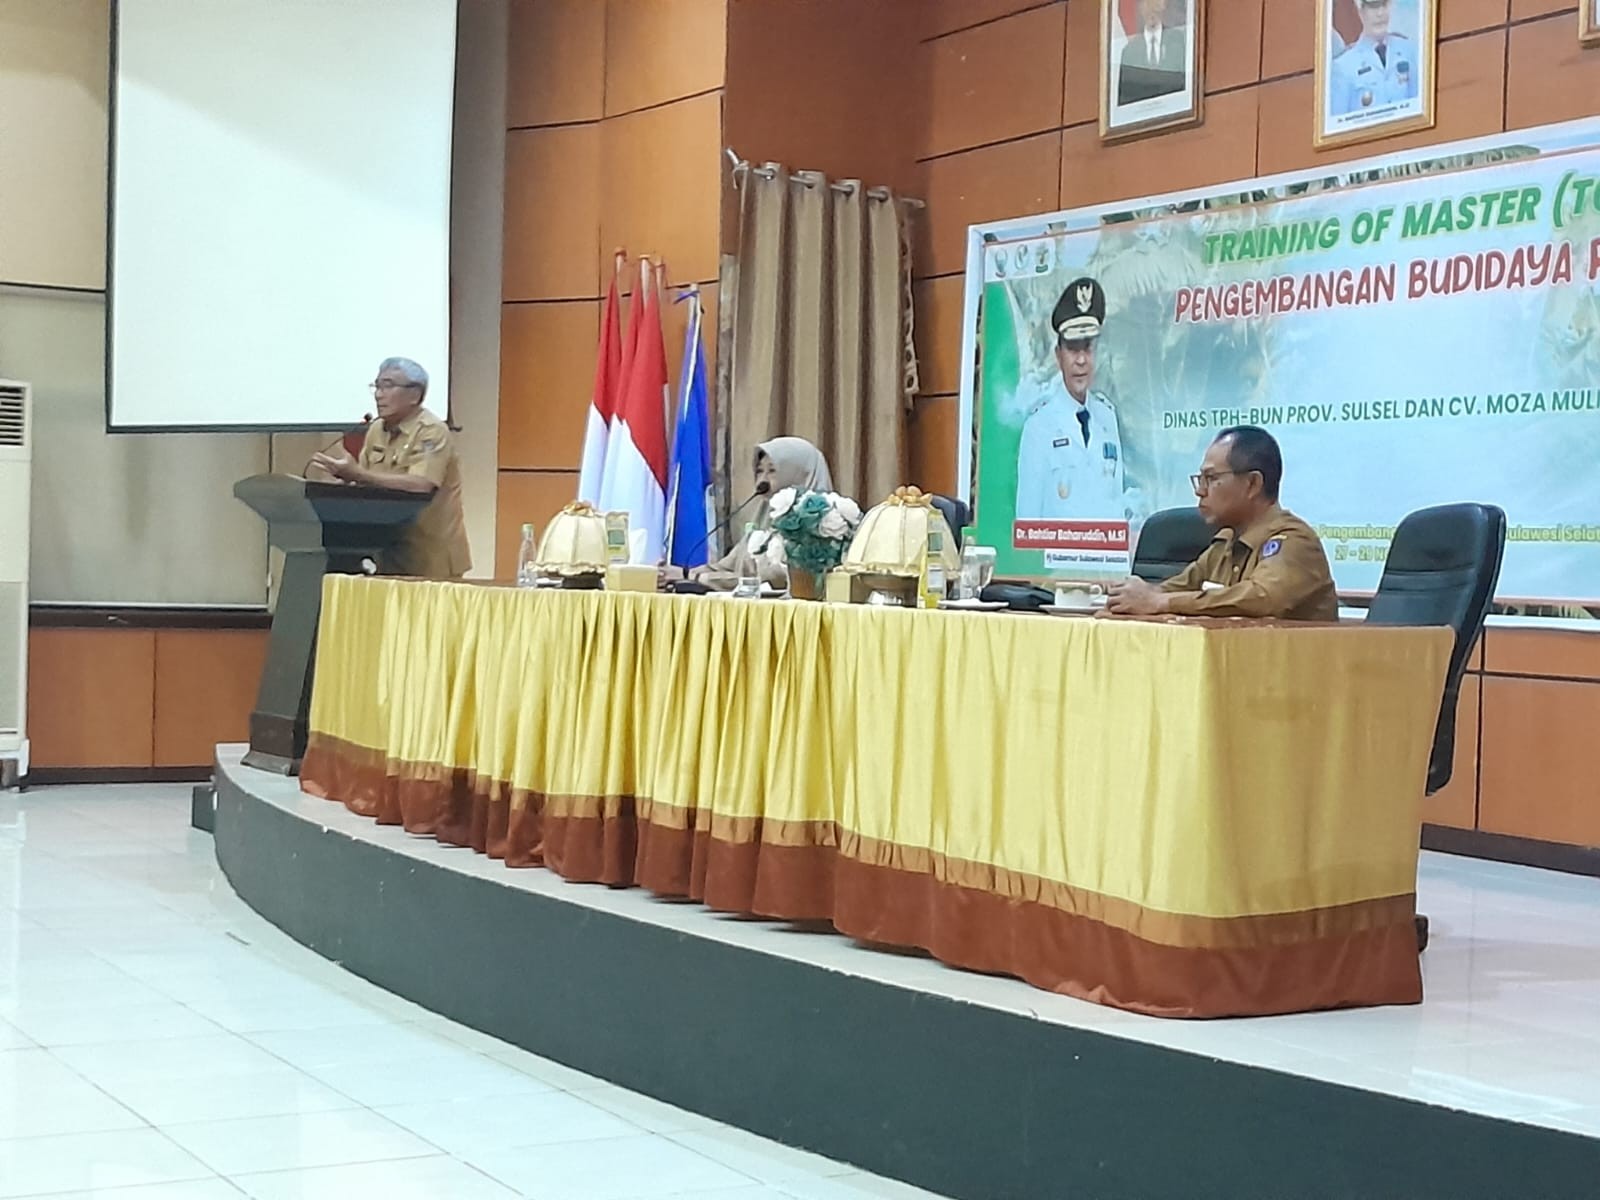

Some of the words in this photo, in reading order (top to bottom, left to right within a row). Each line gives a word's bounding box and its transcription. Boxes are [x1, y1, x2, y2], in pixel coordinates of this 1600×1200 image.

[1204, 216, 1341, 265] TRAINING
[1351, 207, 1394, 245] OF
[1401, 186, 1542, 238] MASTER
[1175, 262, 1396, 323] PENGEMBANGAN
[1407, 241, 1571, 299] BUDIDAYA
[1163, 410, 1208, 429] DINAS
[1211, 406, 1283, 426] TPH-BUN
[1286, 403, 1337, 424] PROV.
[1341, 399, 1401, 421] SULSEL
[1404, 396, 1444, 419] DAN
[1448, 394, 1481, 416] CV.
[1486, 391, 1546, 414] MOZA
[1015, 528, 1027, 540] Dr.
